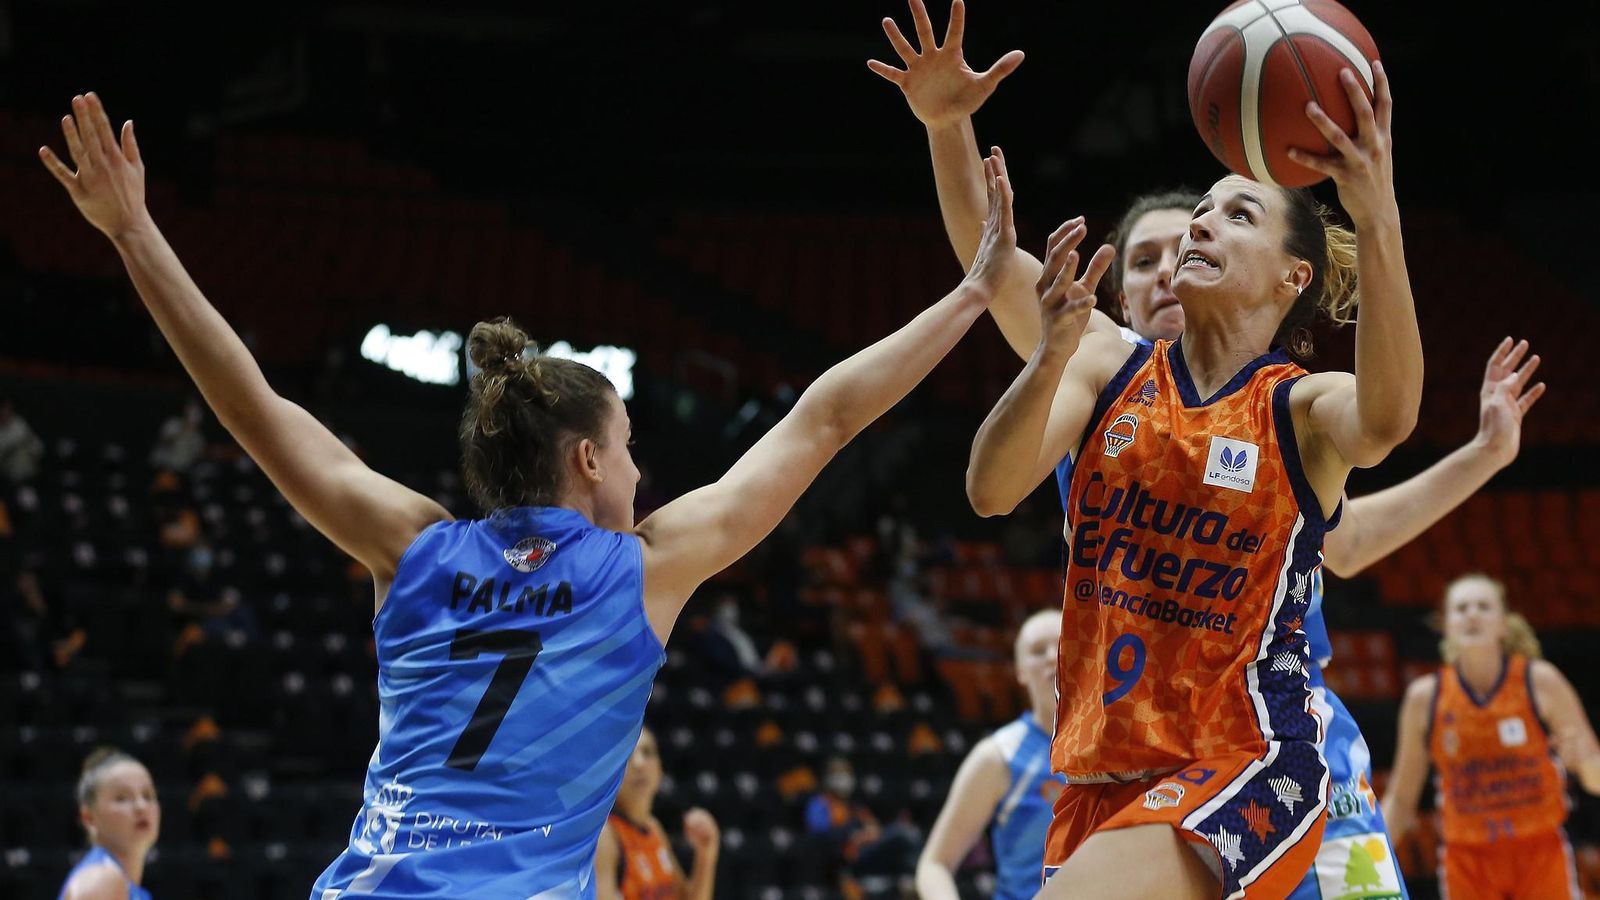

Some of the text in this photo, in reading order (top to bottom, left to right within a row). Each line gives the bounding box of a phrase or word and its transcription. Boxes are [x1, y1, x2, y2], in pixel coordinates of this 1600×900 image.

[1079, 471, 1267, 554] Cultura del
[1208, 471, 1251, 486] LF endesa
[450, 571, 573, 617] PALMA
[1072, 521, 1249, 601] Efuerzo
[443, 628, 544, 772] 7
[1102, 632, 1147, 707] 9
